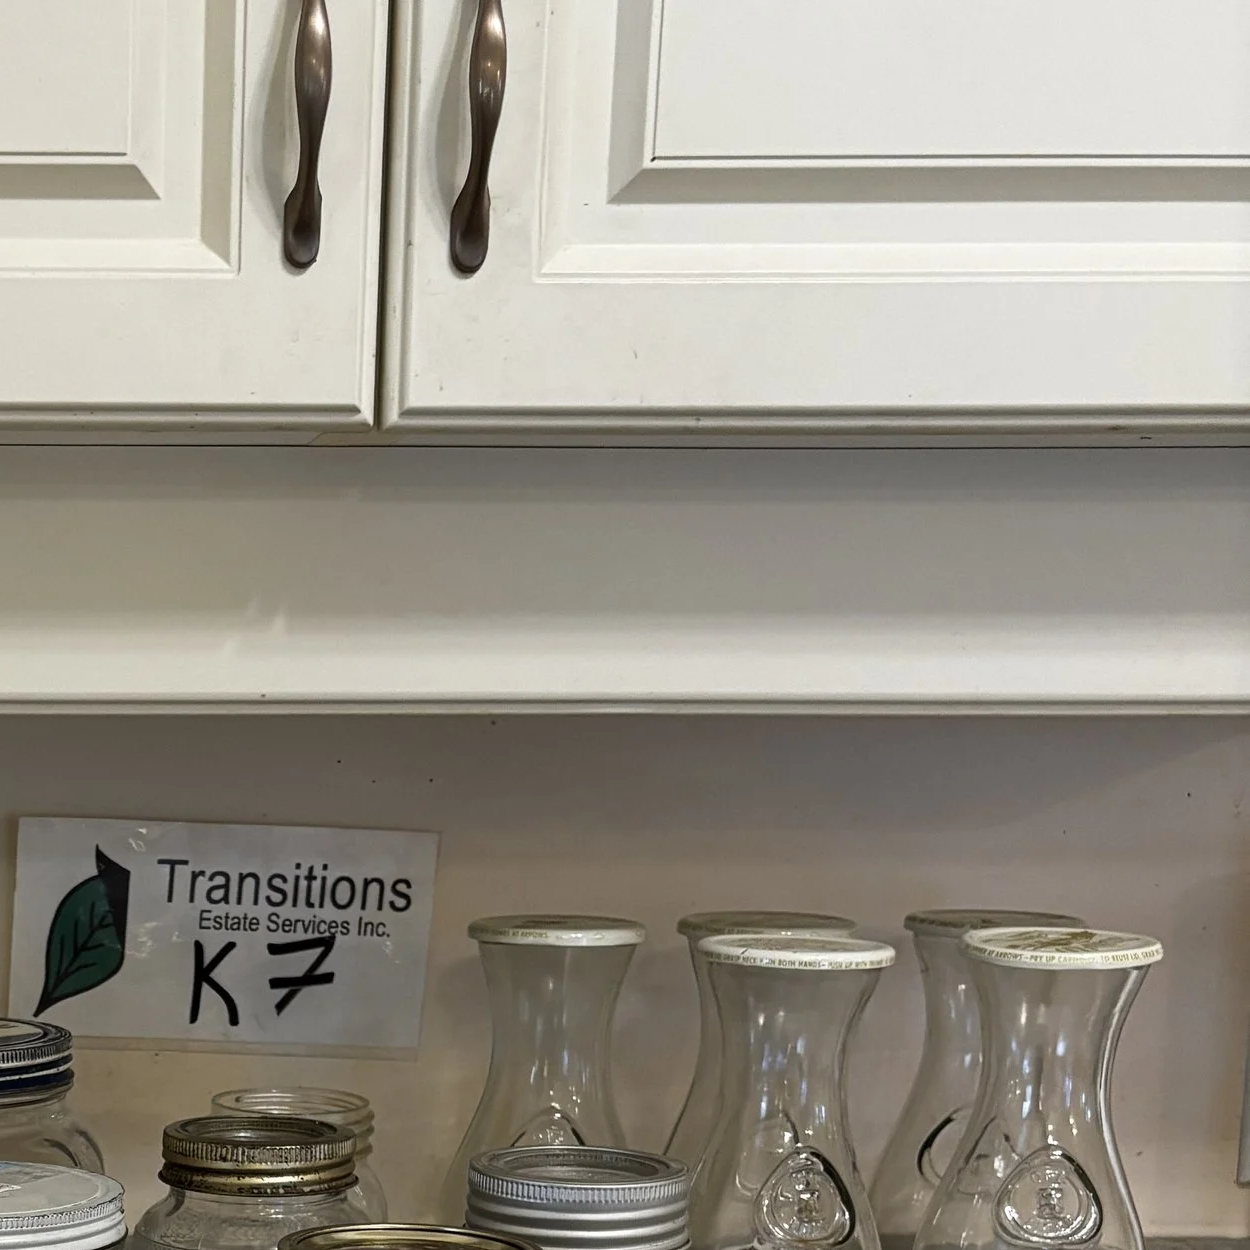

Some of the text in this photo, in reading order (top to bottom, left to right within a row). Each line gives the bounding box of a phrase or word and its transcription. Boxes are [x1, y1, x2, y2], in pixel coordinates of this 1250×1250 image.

[156, 857, 413, 913] Transitions
[198, 910, 391, 939] Estate Services Inc.
[189, 935, 336, 1027] K 7
